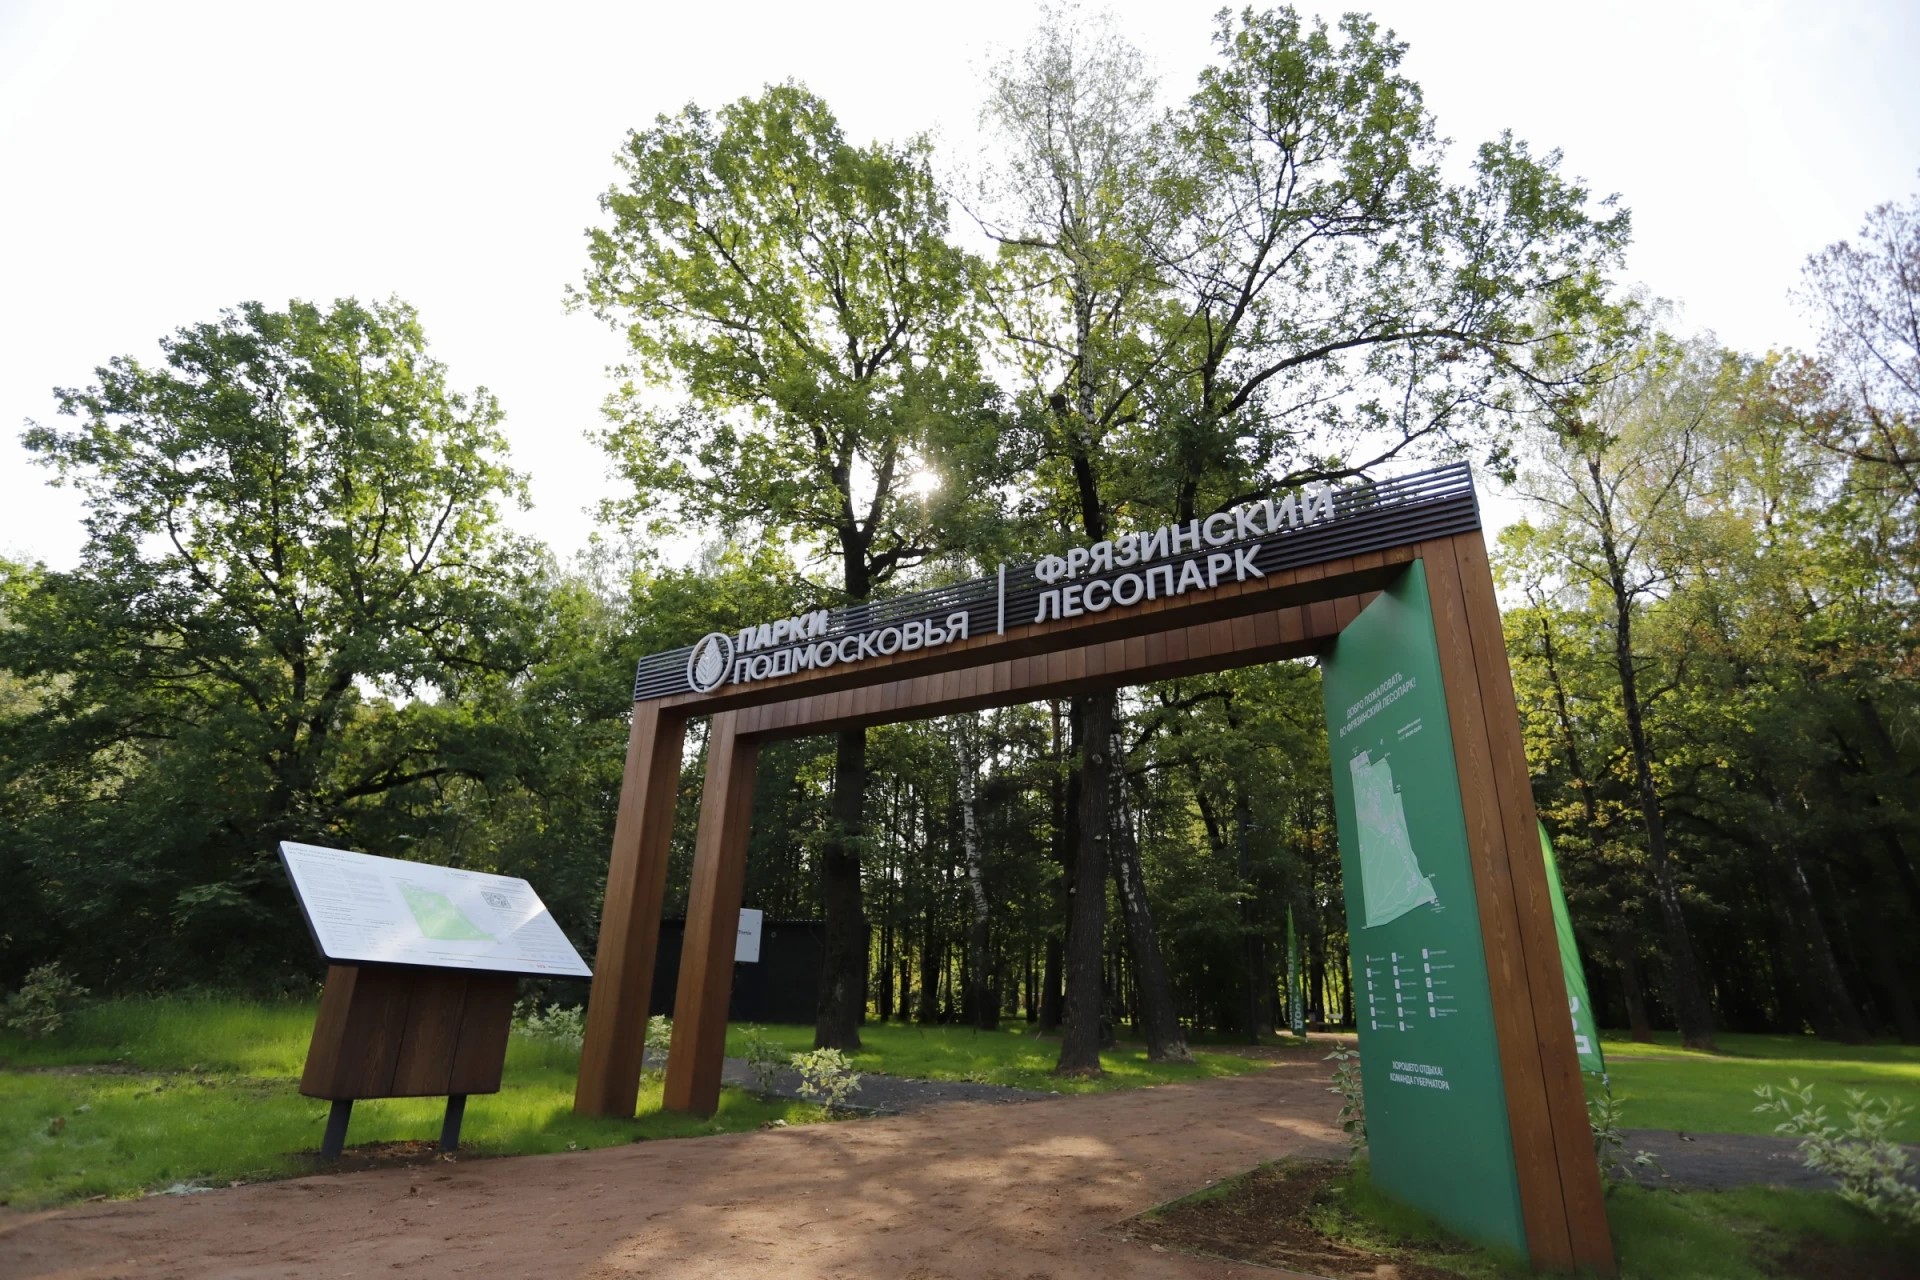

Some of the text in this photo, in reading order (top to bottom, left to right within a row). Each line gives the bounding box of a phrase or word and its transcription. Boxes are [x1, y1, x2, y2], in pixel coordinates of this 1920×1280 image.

[1034, 480, 1336, 584] ФРЯЗИНСКИЙ
[1034, 544, 1266, 624] ЛЕСОПАРК
[733, 611, 969, 684] ПОДМОСКОВЬЯ
[737, 609, 829, 653] ПАРКИ
[1347, 672, 1402, 719] ДОБРО ПОЖАЛОВАТЬ
[1340, 726, 1347, 738] ВО
[1347, 700, 1382, 732] ФРЯЗИНСКИЙ
[1390, 1072, 1450, 1091] КОМАНДА ГУБЕРНАТОРА
[1392, 1060, 1419, 1073] ХОРОШЕГО
